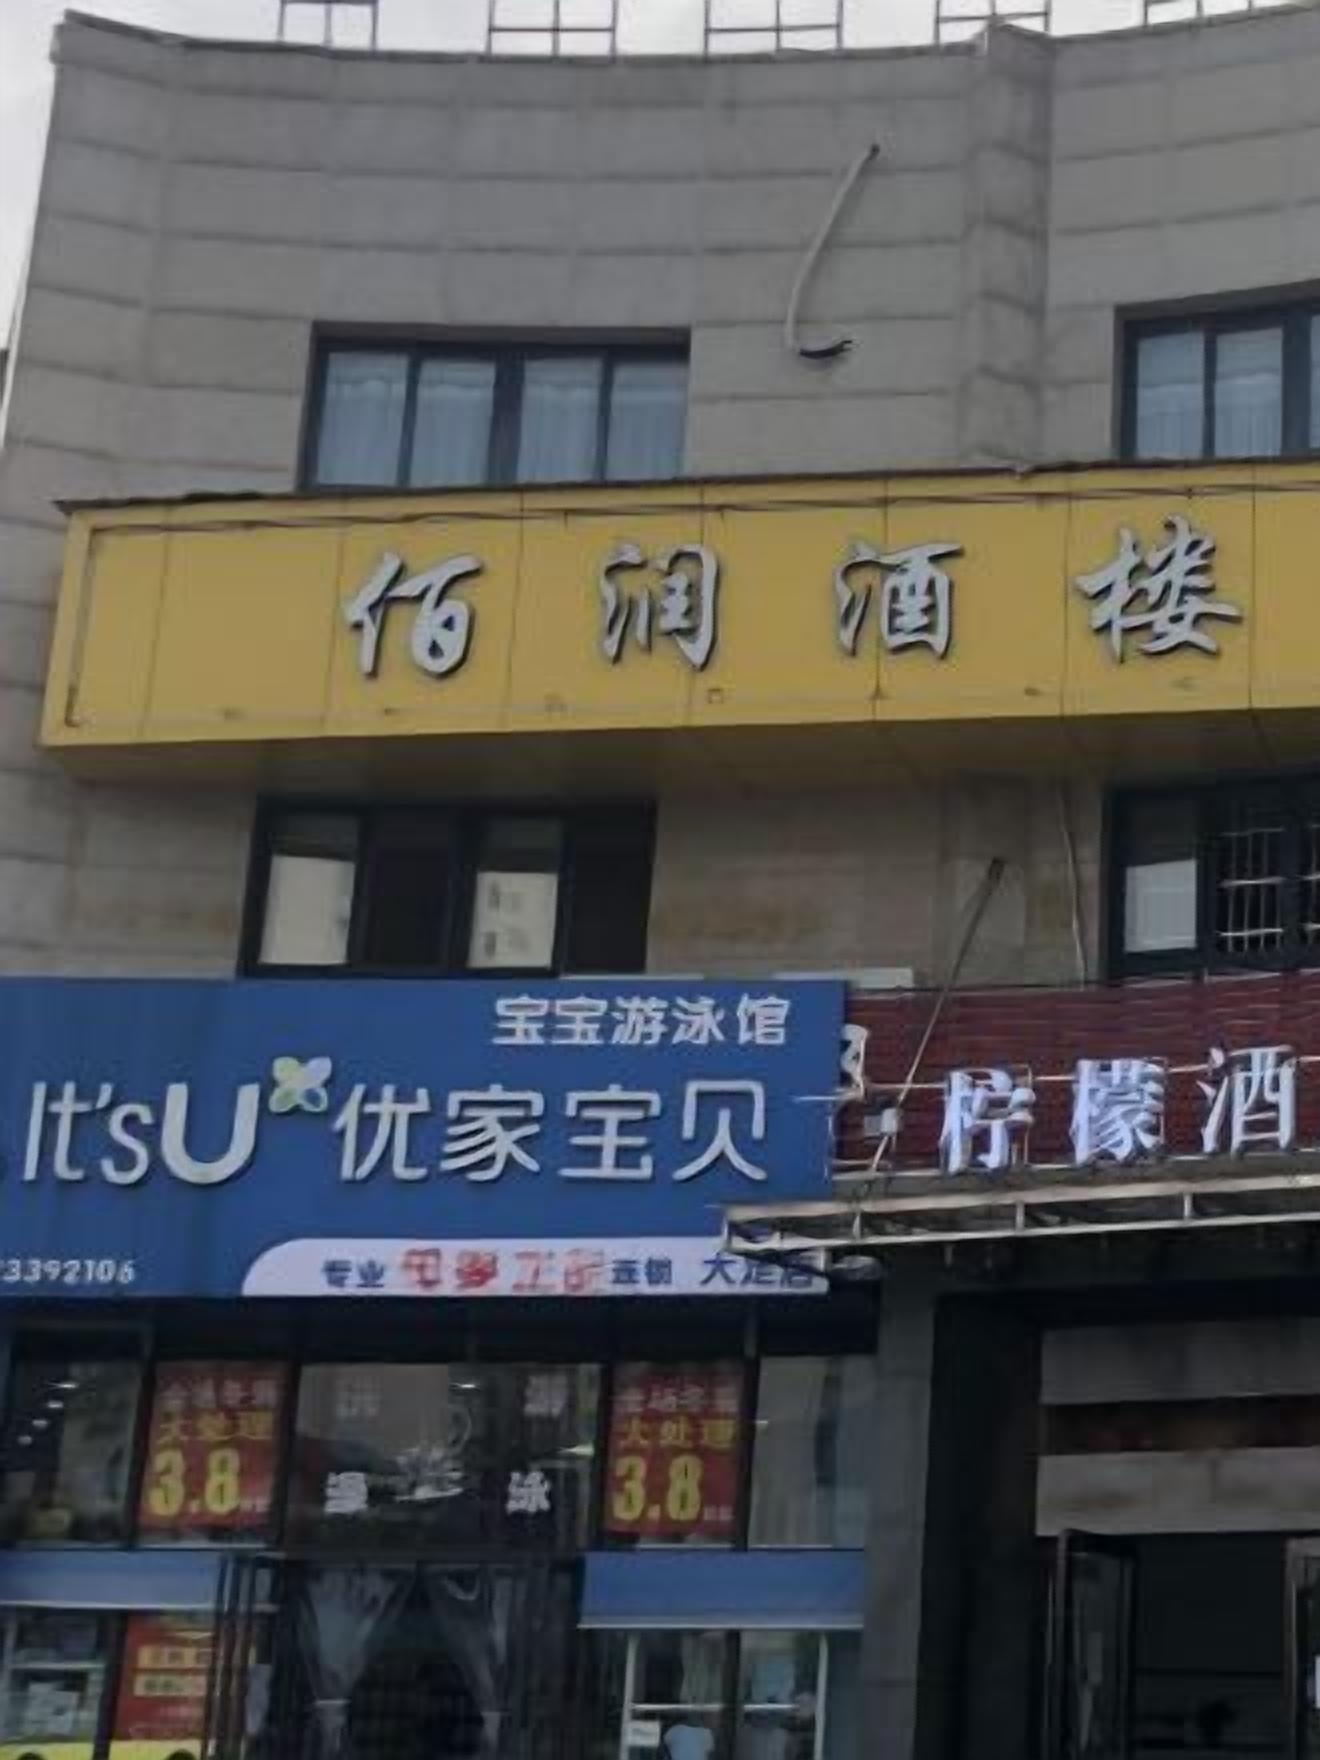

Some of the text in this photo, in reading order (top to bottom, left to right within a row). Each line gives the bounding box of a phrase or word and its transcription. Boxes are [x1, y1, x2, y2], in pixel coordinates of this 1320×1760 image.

[344, 515, 1243, 679] 佰润酒楼
[492, 992, 792, 1045] 宝宝游泳馆
[333, 1079, 768, 1182] 优家宝贝
[0, 1258, 136, 1284] 3392106
